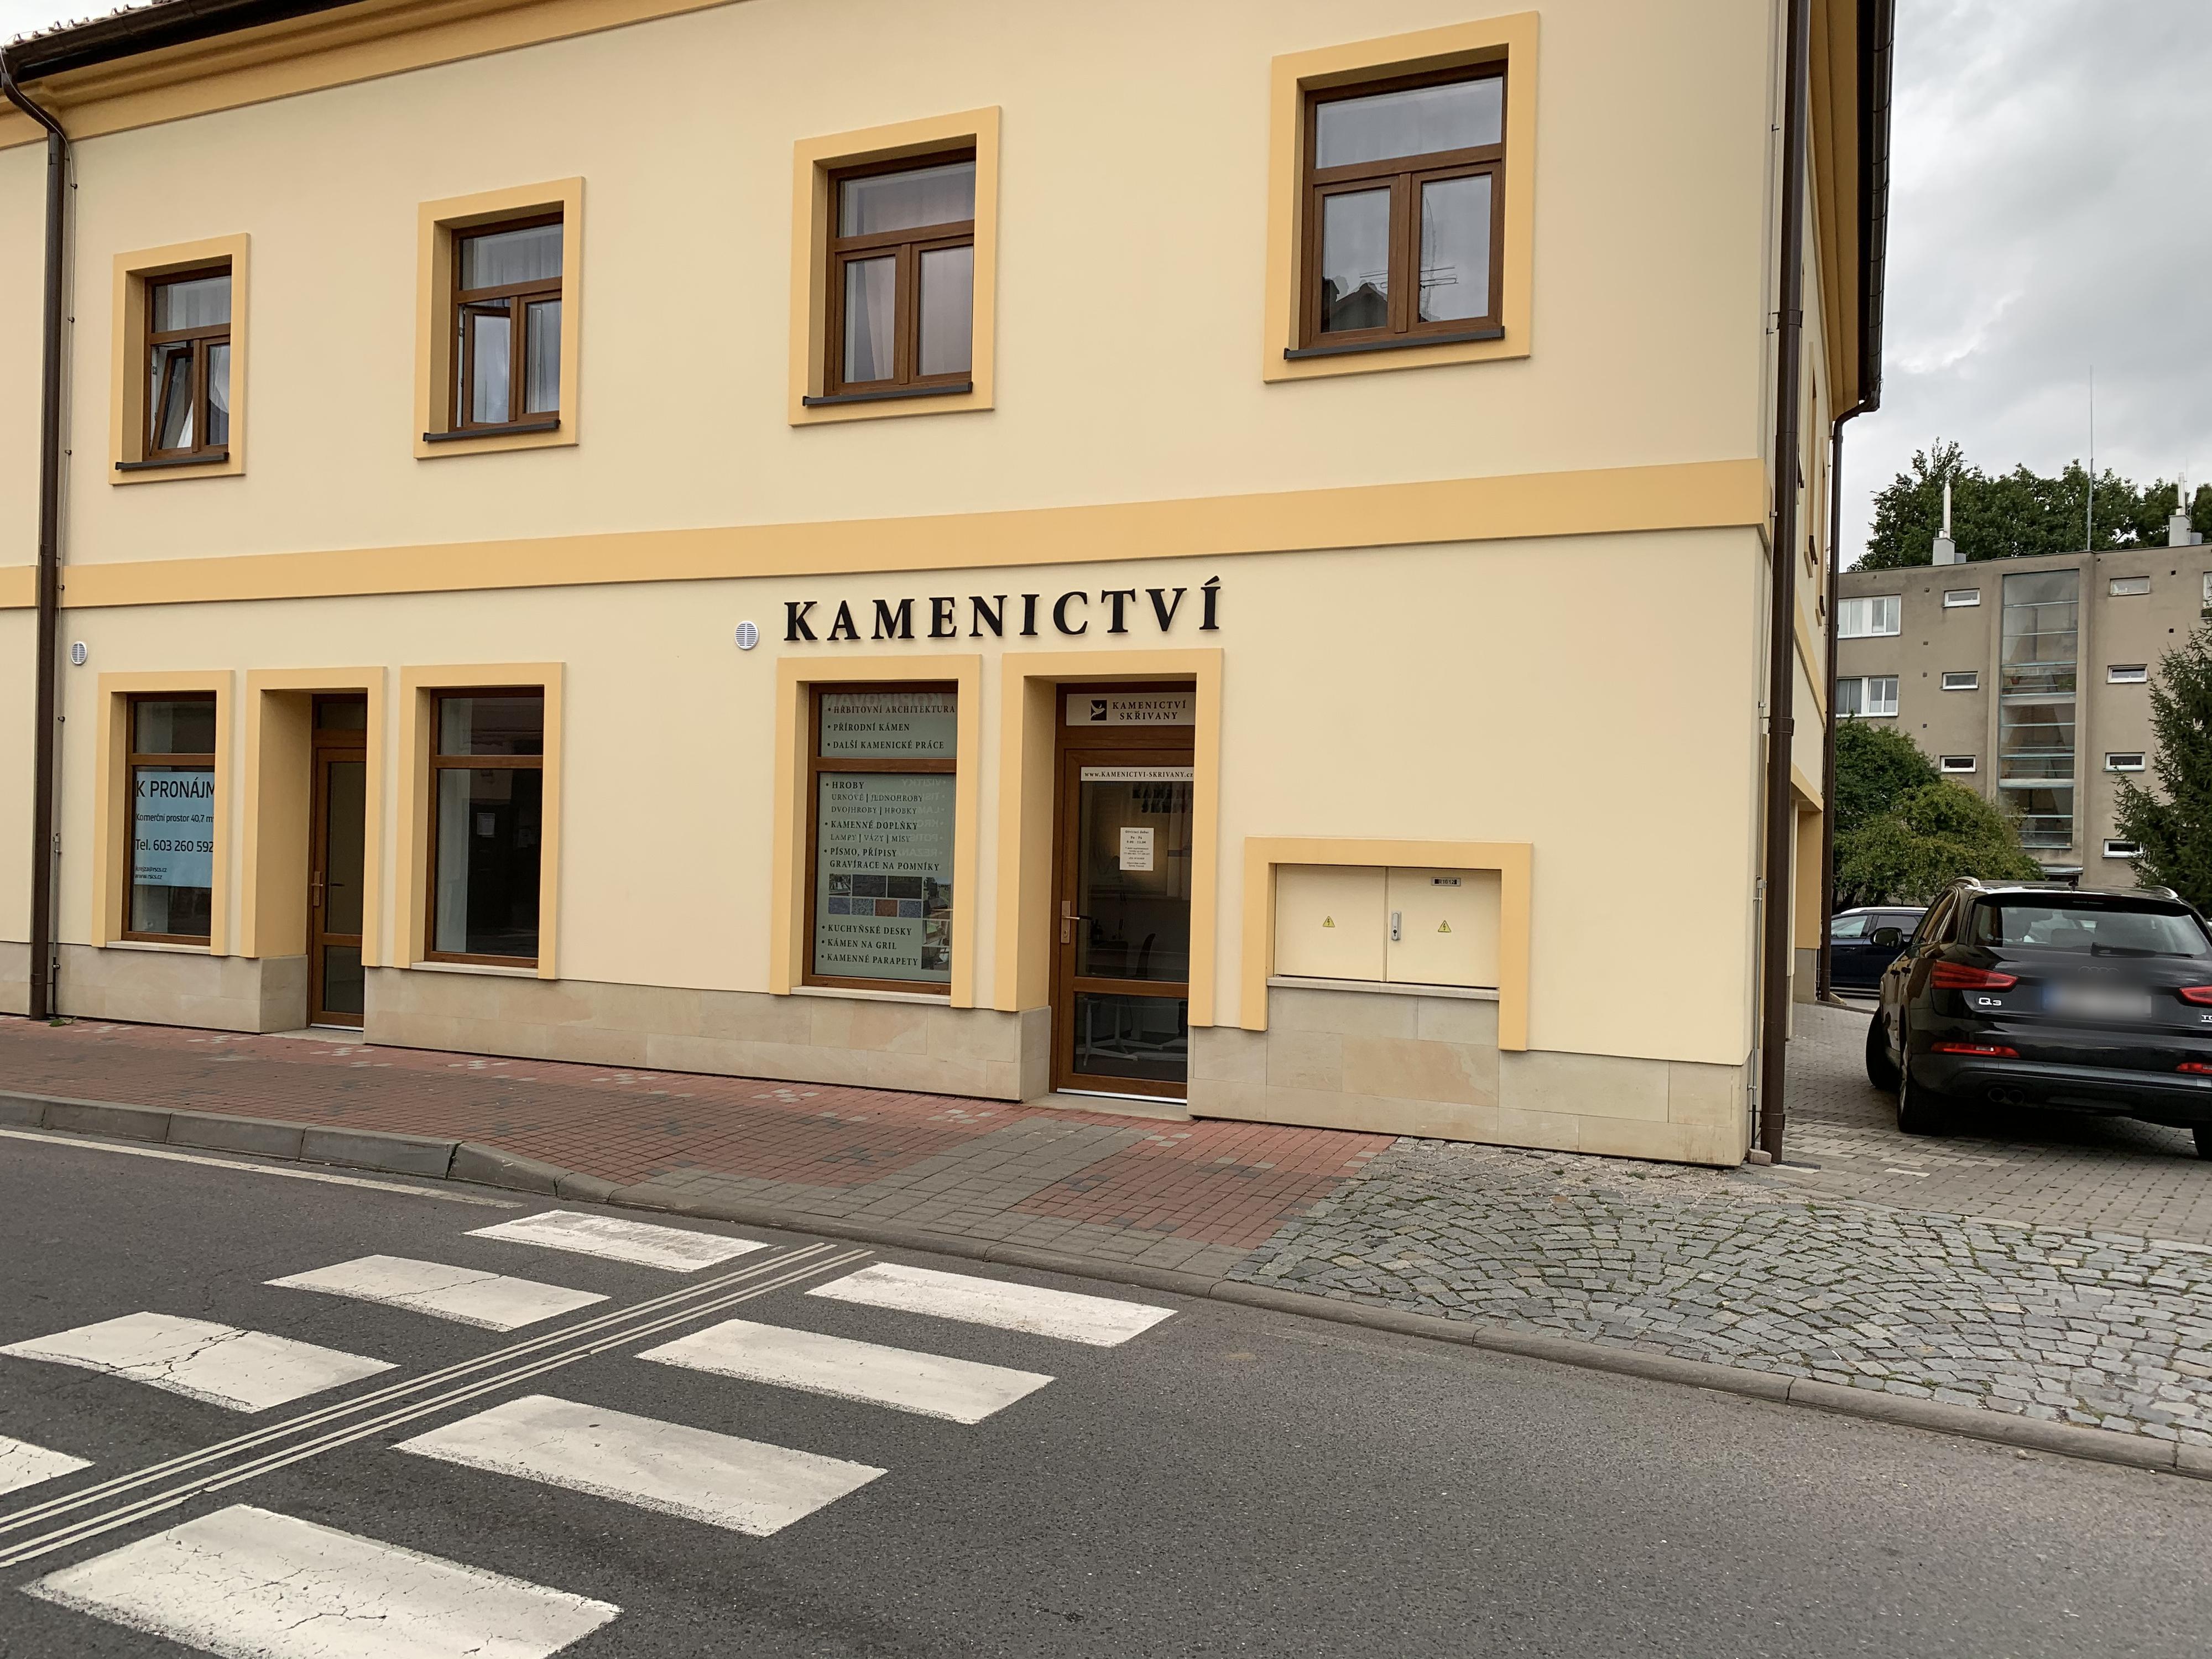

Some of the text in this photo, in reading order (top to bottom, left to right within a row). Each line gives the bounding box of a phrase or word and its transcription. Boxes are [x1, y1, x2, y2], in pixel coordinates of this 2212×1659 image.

[784, 576, 1221, 641] KAMENICTVÍ
[833, 705, 956, 713] HŘBITOVNÍ ARCHITEKTURA
[1113, 700, 1186, 709] KAMENICTVÍ
[1120, 711, 1178, 720] SKŘIVANY
[833, 722, 910, 731] PŘÍRODNÍ KÁMEN
[833, 740, 944, 749] DALŠÍ KAMENICKÉ PRÁCE
[137, 780, 145, 797] K
[136, 813, 165, 822] Komerční
[166, 815, 190, 823] prostor
[191, 815, 204, 823] 40,7
[831, 820, 873, 829] KAMENNÉ
[877, 821, 918, 830] DOPLŇKY
[891, 834, 911, 842] MÍSY
[136, 839, 213, 852] Tel. 603 260 592
[830, 847, 859, 857] PÍSMO,
[863, 847, 897, 857] PŘÍPISY
[830, 860, 879, 869] GRAVÍRACE
[898, 862, 939, 871] POMNÍKY
[828, 925, 912, 936] KUCHYŇSKÉ DESKY
[827, 938, 858, 948] KÁMEN
[827, 954, 918, 966] KAMENNÉ PARAPETY
[1978, 997, 2002, 1006] Q3
